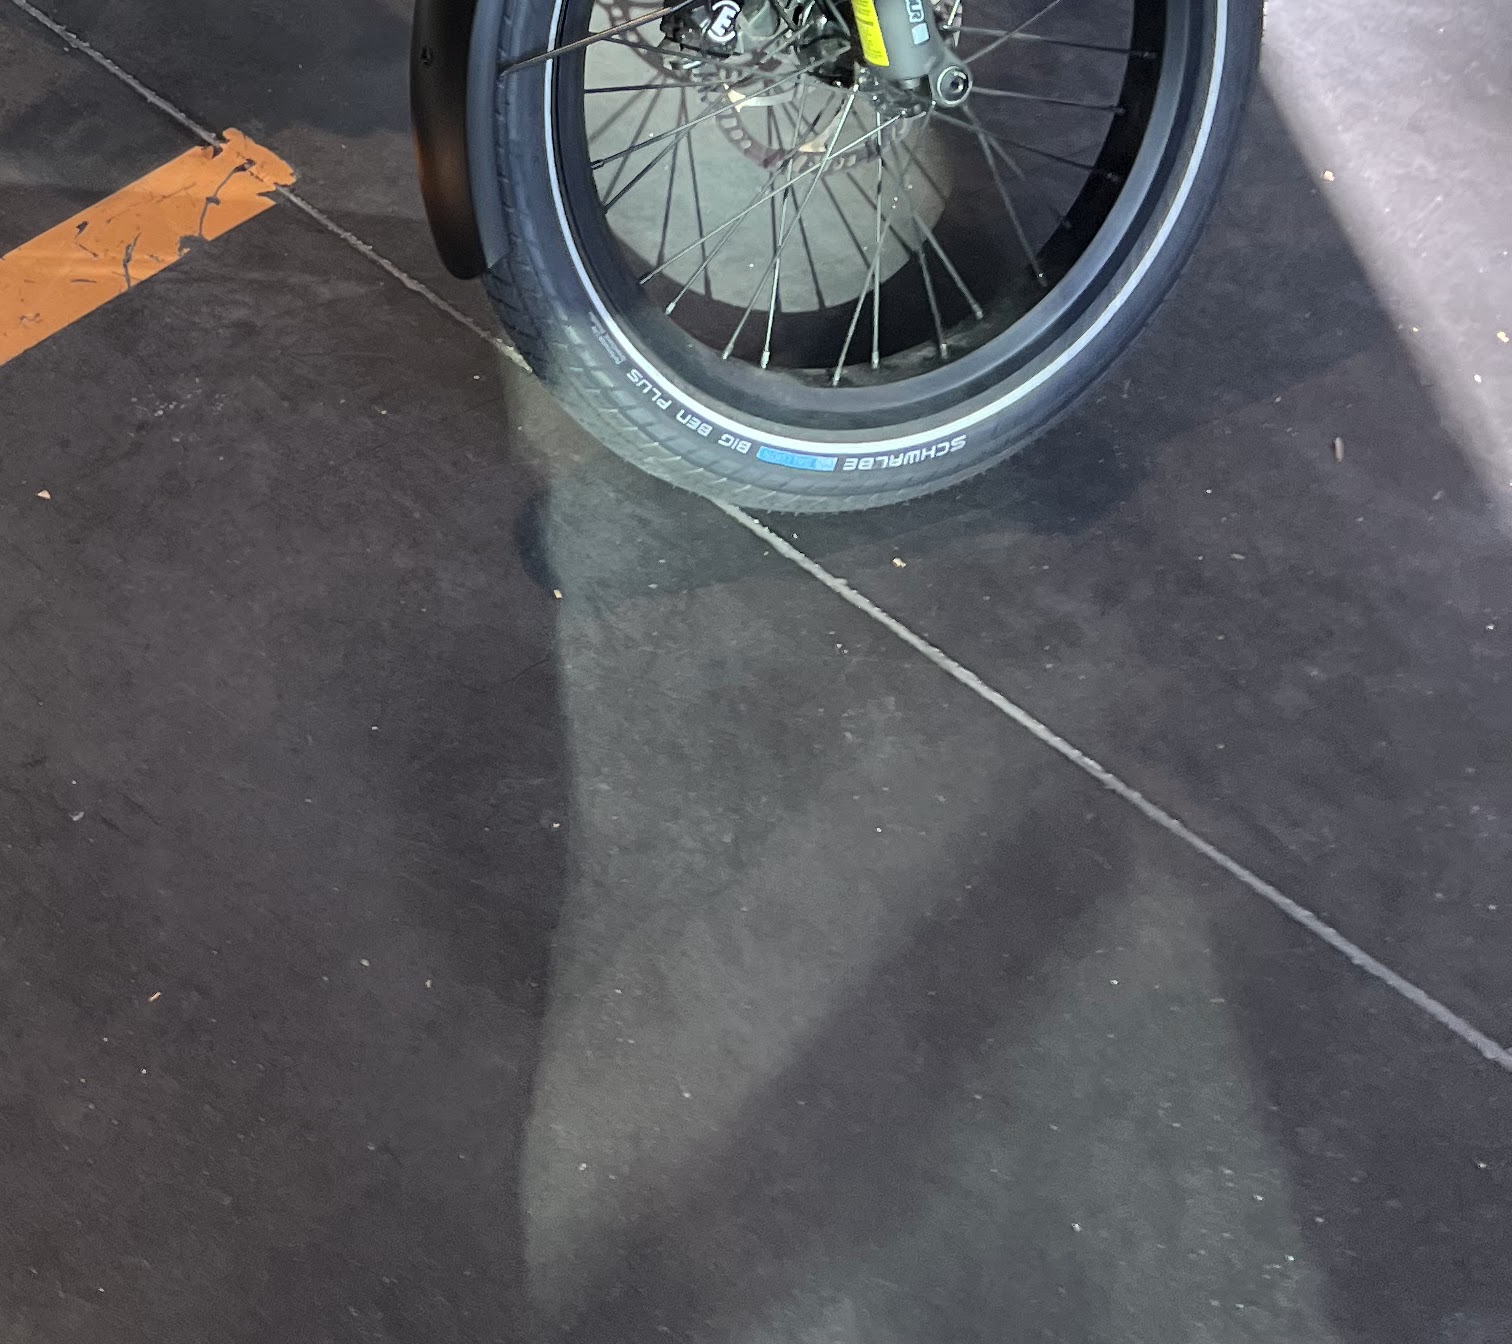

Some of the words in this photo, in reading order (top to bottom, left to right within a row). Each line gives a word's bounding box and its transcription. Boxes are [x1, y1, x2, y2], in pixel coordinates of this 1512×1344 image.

[626, 368, 672, 410] PLUS
[675, 409, 713, 437] BEN
[717, 433, 752, 454] BIG
[842, 434, 968, 472] SCHWALBE
